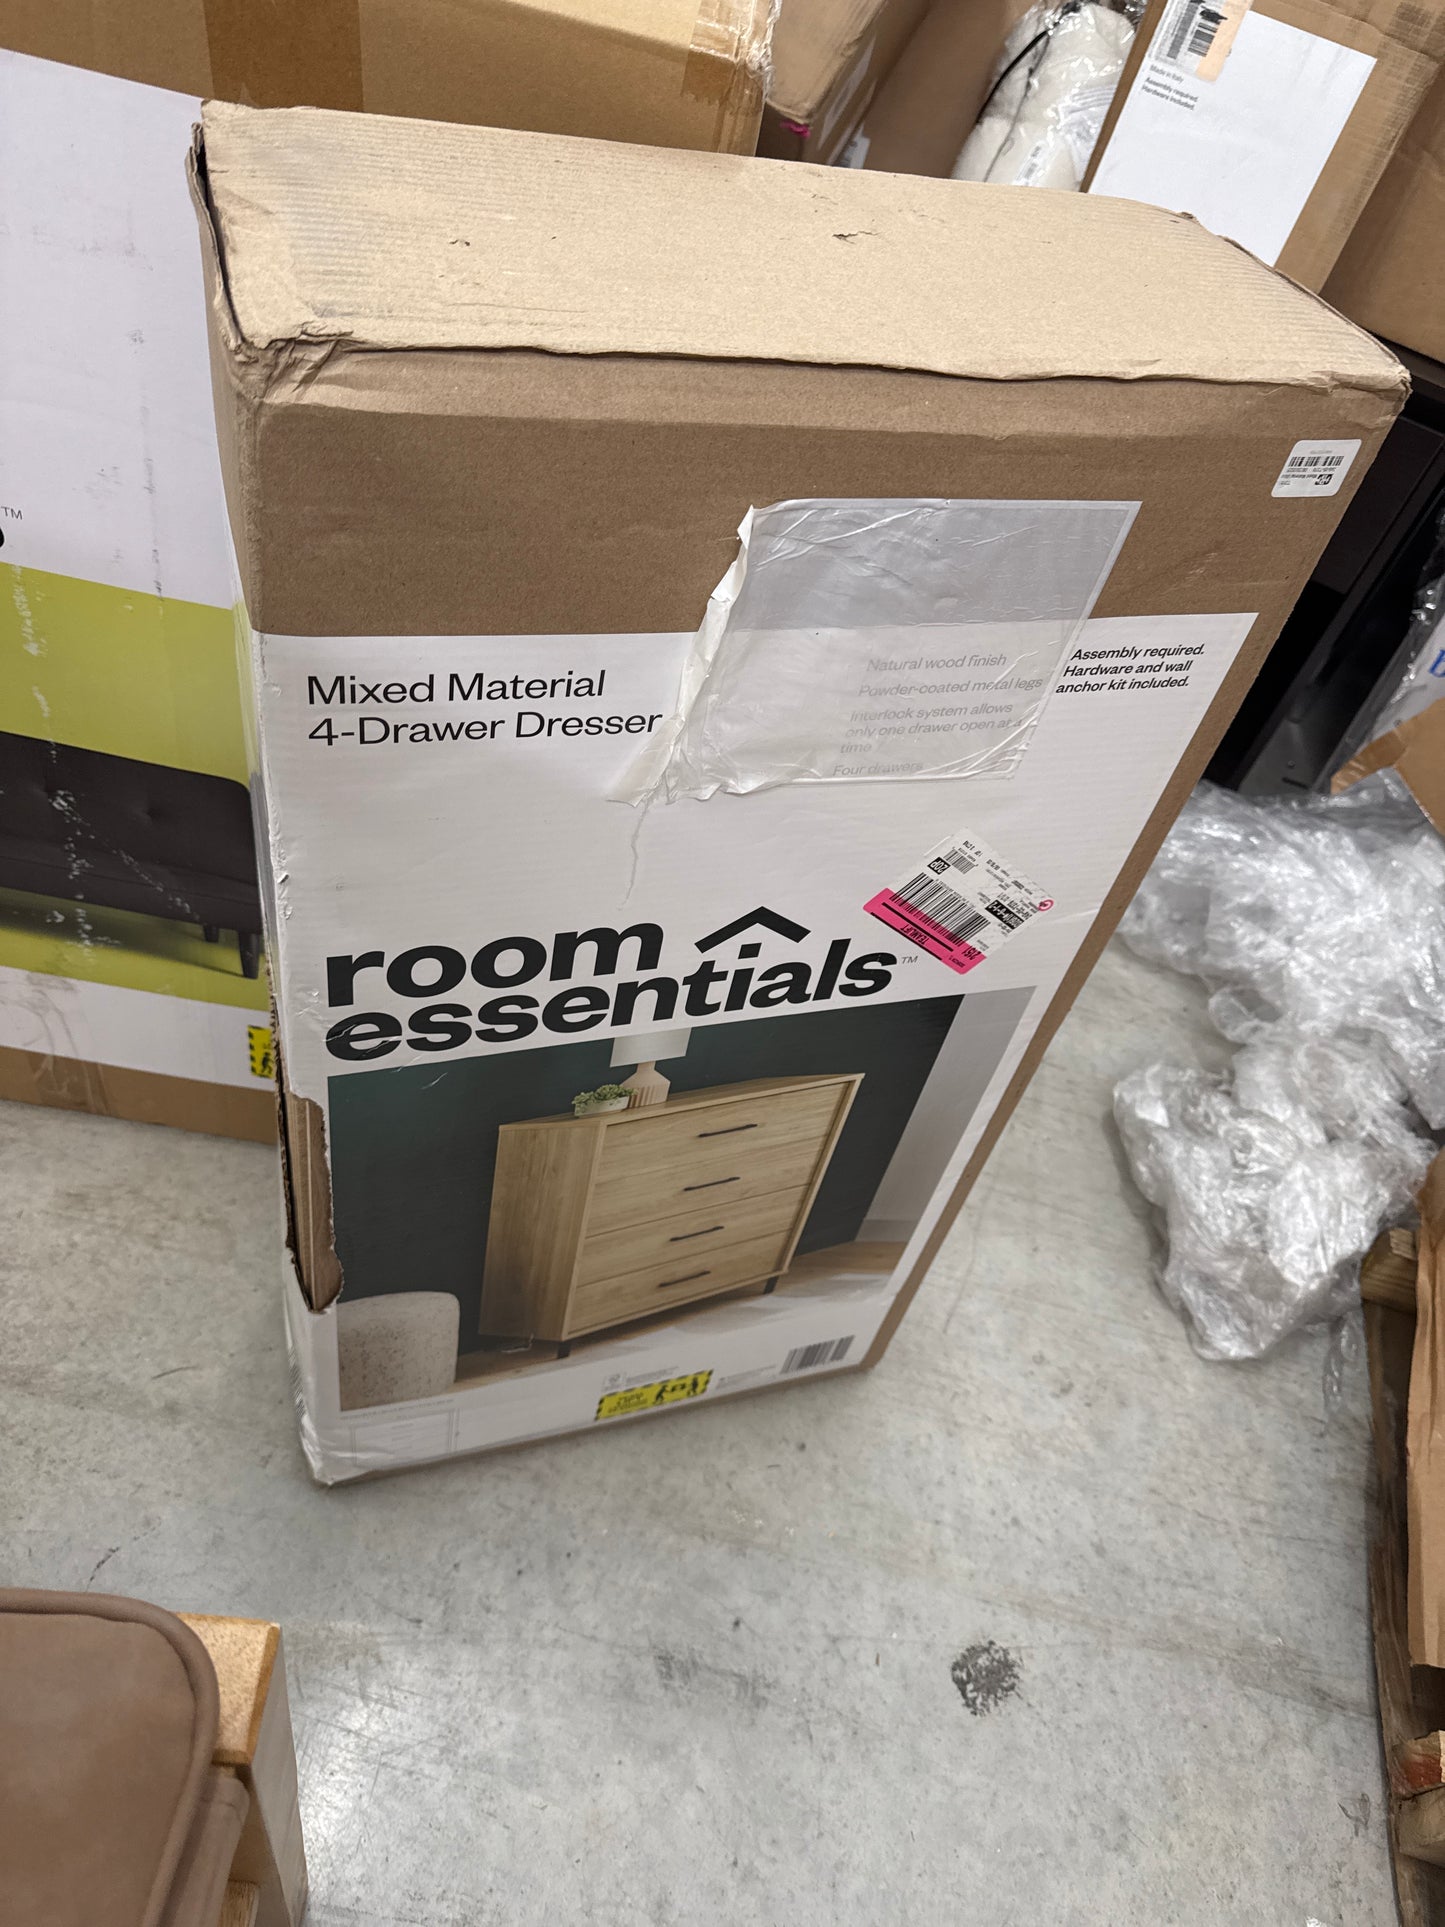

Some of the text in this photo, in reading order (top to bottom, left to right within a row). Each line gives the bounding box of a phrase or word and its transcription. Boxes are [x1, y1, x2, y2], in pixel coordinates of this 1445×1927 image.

[1142, 85, 1169, 100] Hardware
[1145, 77, 1172, 93] Assembly
[1, 506, 23, 520] TM
[1071, 644, 1205, 660] Assembly required.
[866, 654, 1007, 672] Natural wood finish
[1063, 660, 1193, 677] Hardware and wall
[307, 670, 606, 705] Mixed Material
[858, 677, 1044, 697] Powder-coated metal legs
[1056, 676, 1190, 694] anchor kit included.
[850, 703, 1014, 722] Interlock system allows
[308, 710, 662, 746] 4-Drawer Dresser
[845, 726, 876, 738] only
[879, 726, 906, 736] one
[908, 722, 958, 735] drawer
[960, 721, 995, 733] open
[997, 718, 1012, 729] at
[832, 764, 866, 776] Four
[930, 859, 949, 873] 20P
[900, 924, 930, 945] TEAMLIFT
[962, 945, 982, 960] 2151
[326, 922, 665, 1007] room
[324, 937, 919, 1061] essentials TM
